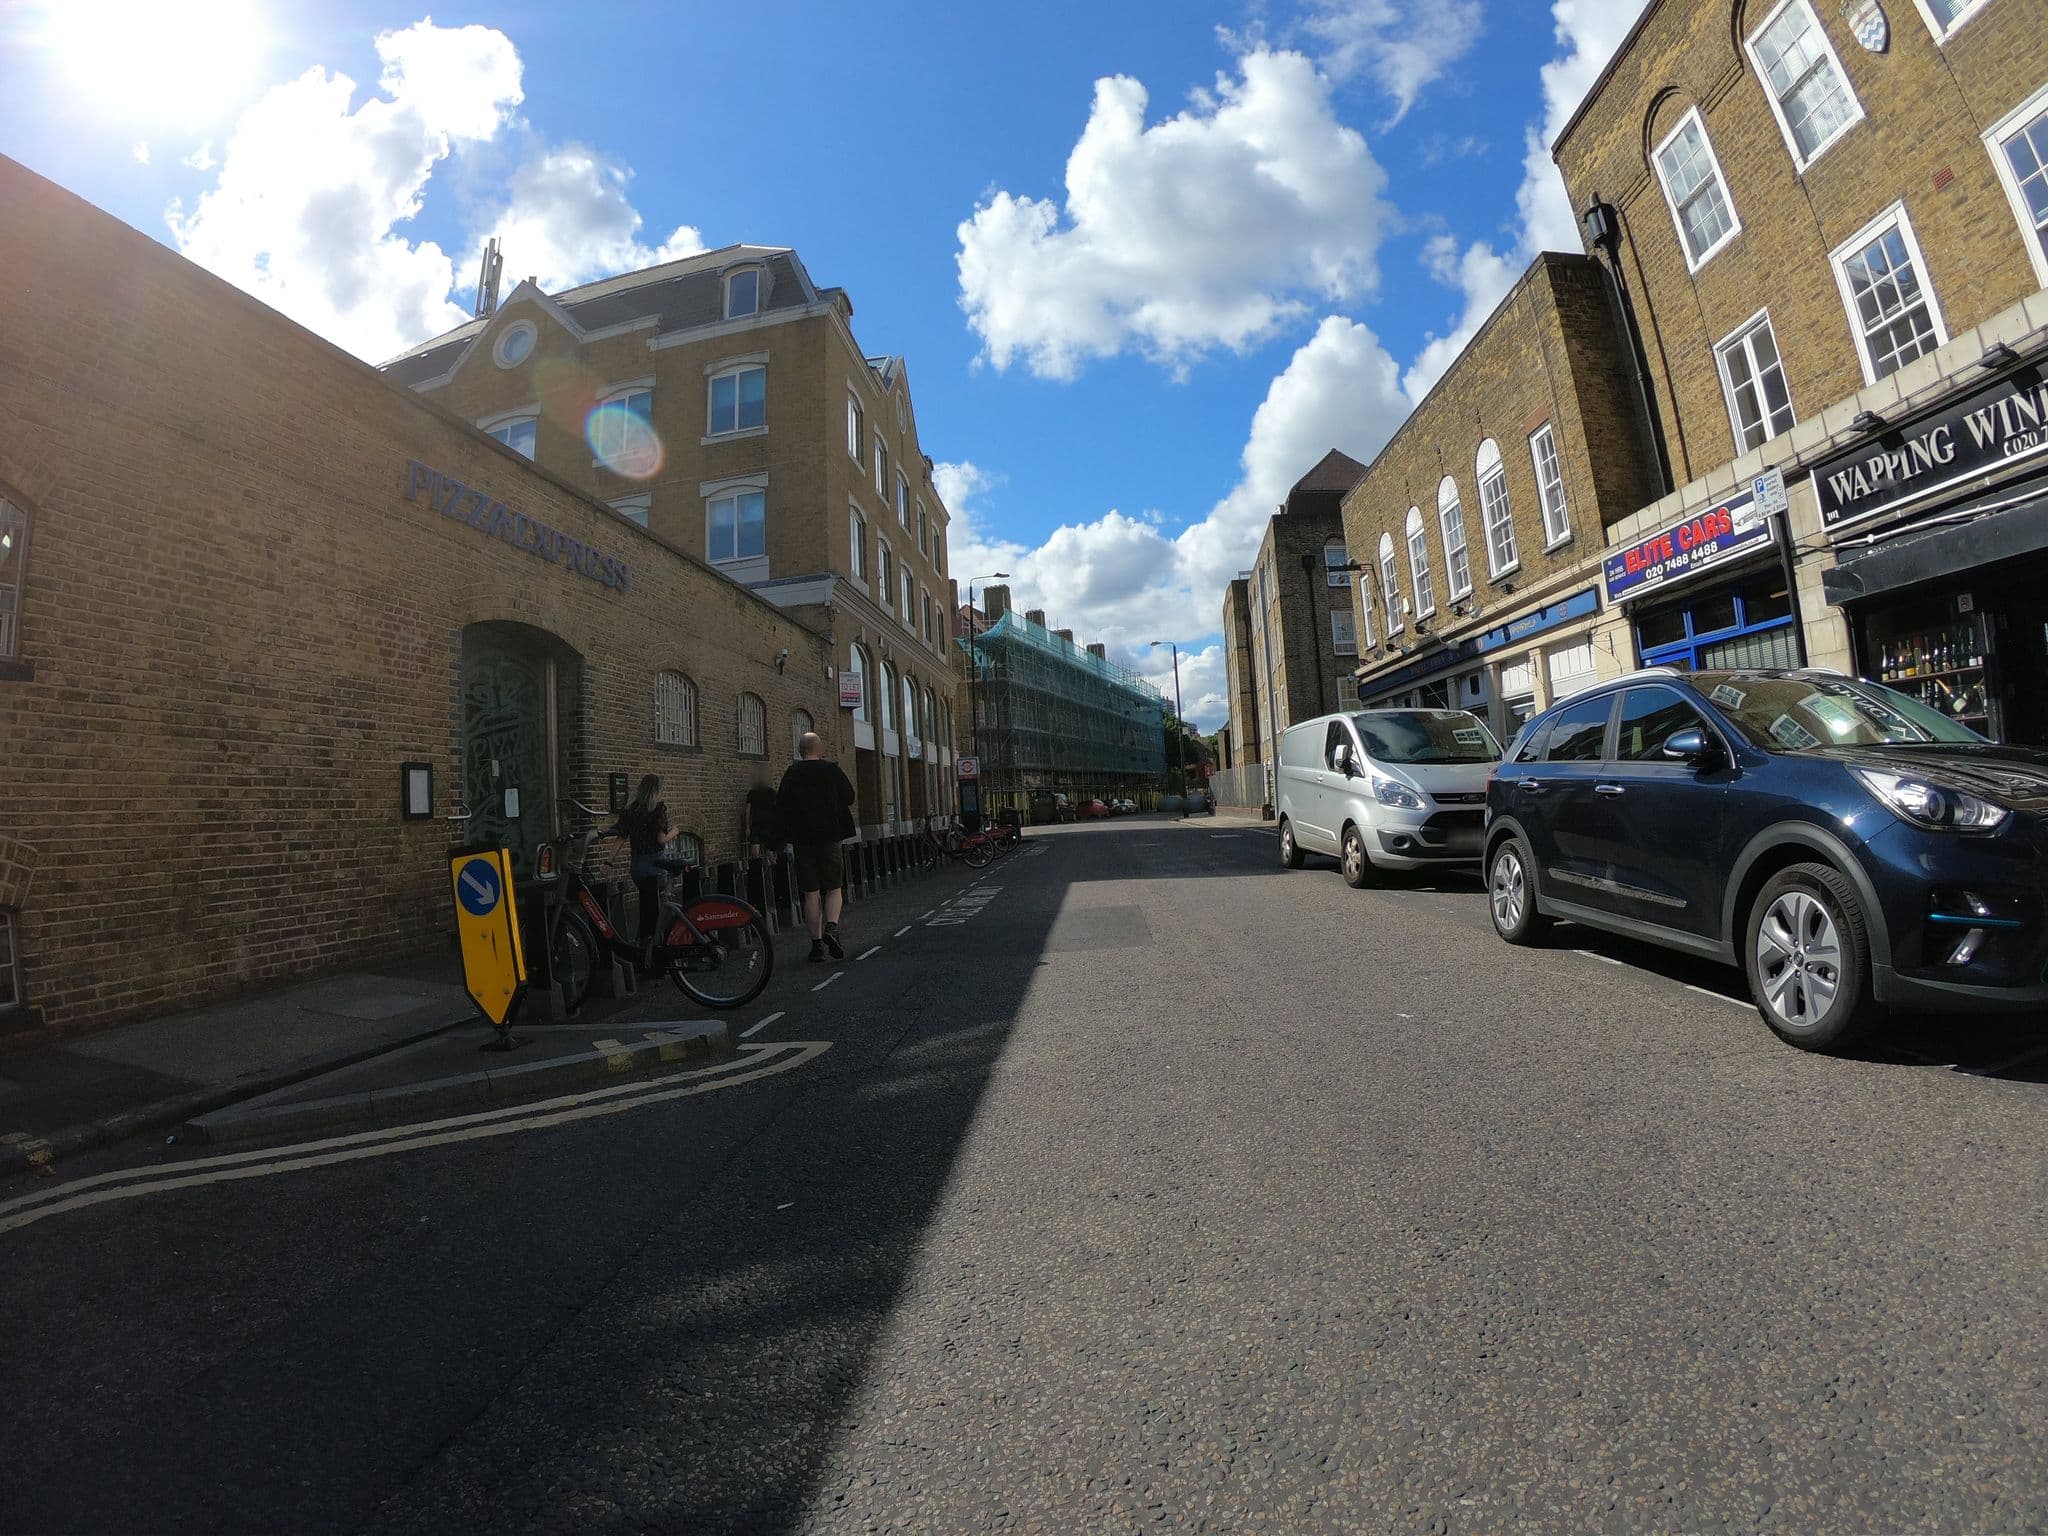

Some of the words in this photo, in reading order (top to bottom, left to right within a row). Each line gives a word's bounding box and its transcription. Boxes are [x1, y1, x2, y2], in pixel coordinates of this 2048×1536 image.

[2012, 431, 2038, 453] 020
[1827, 423, 1956, 506] WAPPING
[1624, 532, 1674, 575] ELITE
[1678, 506, 1733, 550] CARS
[1645, 564, 1664, 580] 020
[1664, 554, 1689, 573] 7488
[1690, 541, 1719, 562] 4488
[704, 910, 739, 921] Santander
